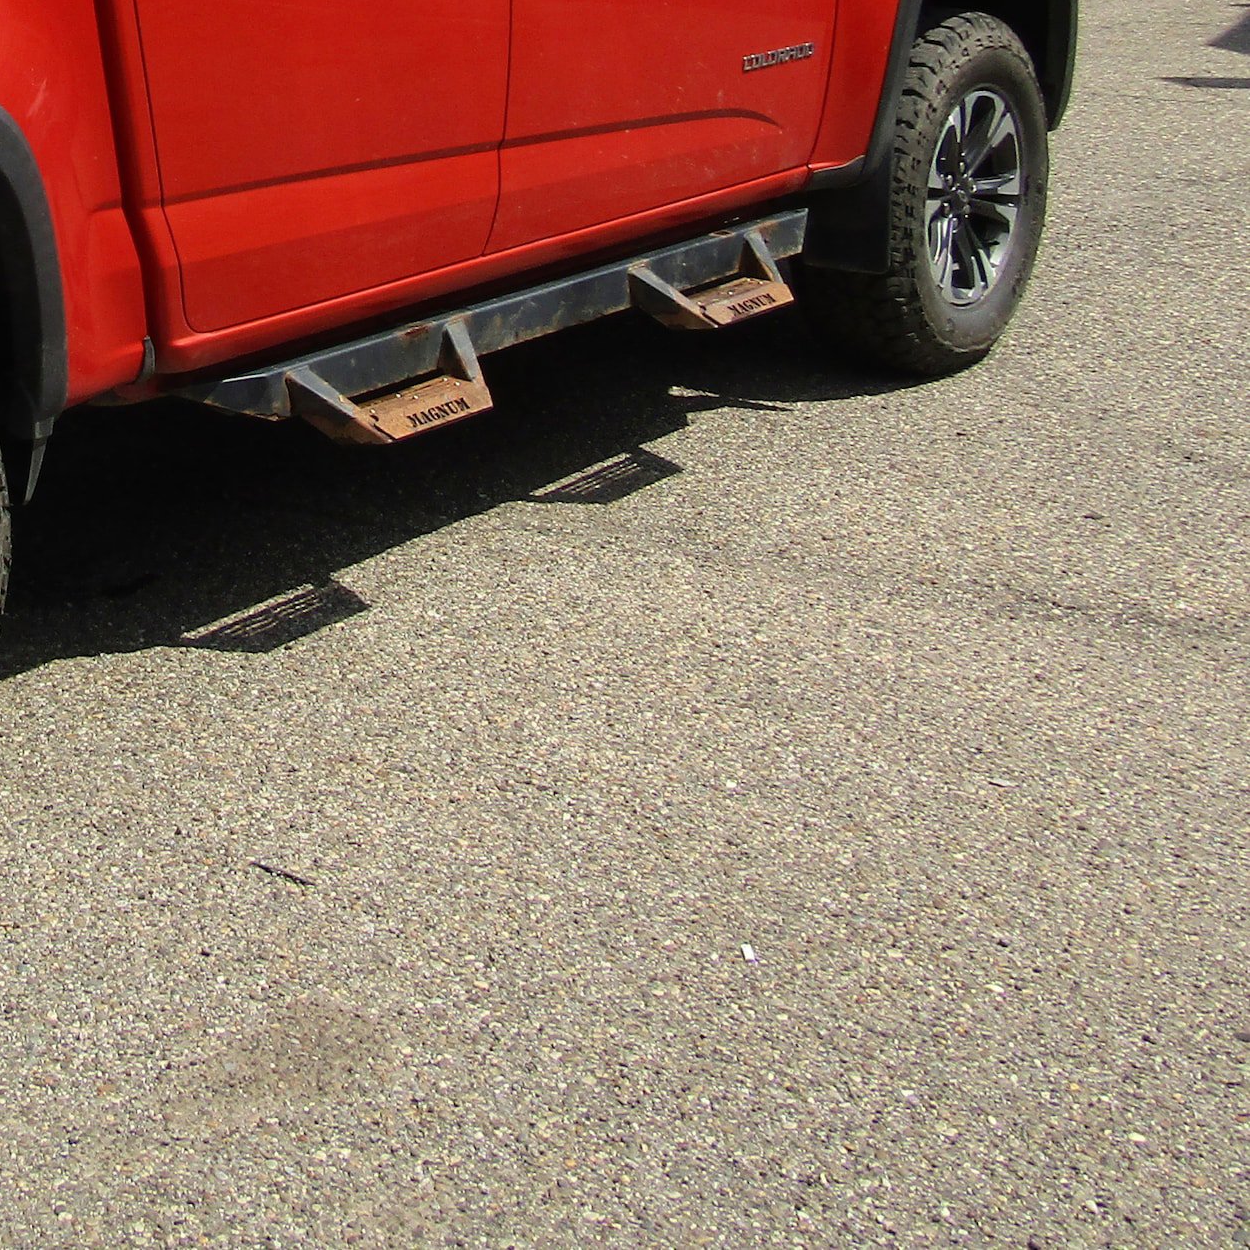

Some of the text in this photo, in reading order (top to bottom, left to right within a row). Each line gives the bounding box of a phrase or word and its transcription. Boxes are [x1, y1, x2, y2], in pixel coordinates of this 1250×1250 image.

[742, 42, 814, 71] COLORADO
[727, 293, 776, 317] MAGNUM
[406, 397, 470, 428] MAGNUM
